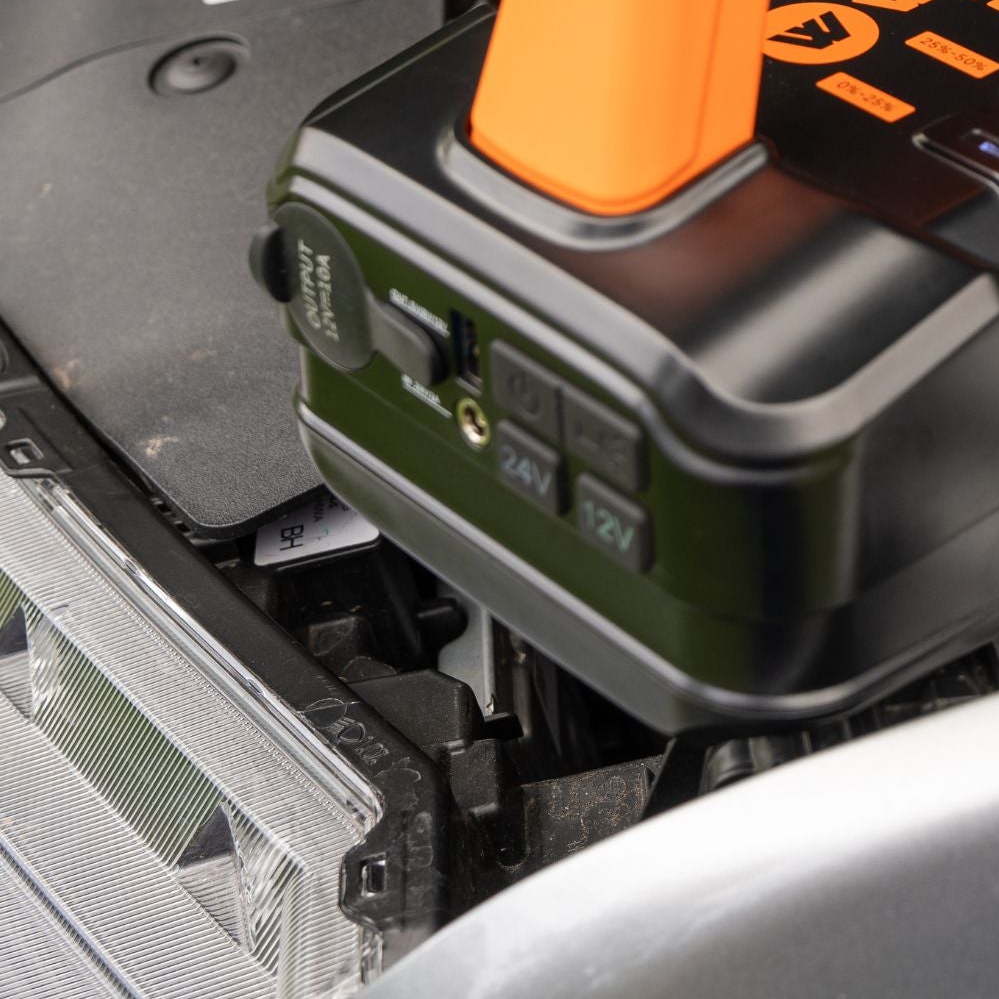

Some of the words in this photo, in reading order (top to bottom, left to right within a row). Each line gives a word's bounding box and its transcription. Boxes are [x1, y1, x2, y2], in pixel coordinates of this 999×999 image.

[919, 37, 988, 72] 25%-50%
[298, 238, 322, 330] OUTPUT
[501, 444, 552, 496] 24V
[583, 500, 636, 553] 12V
